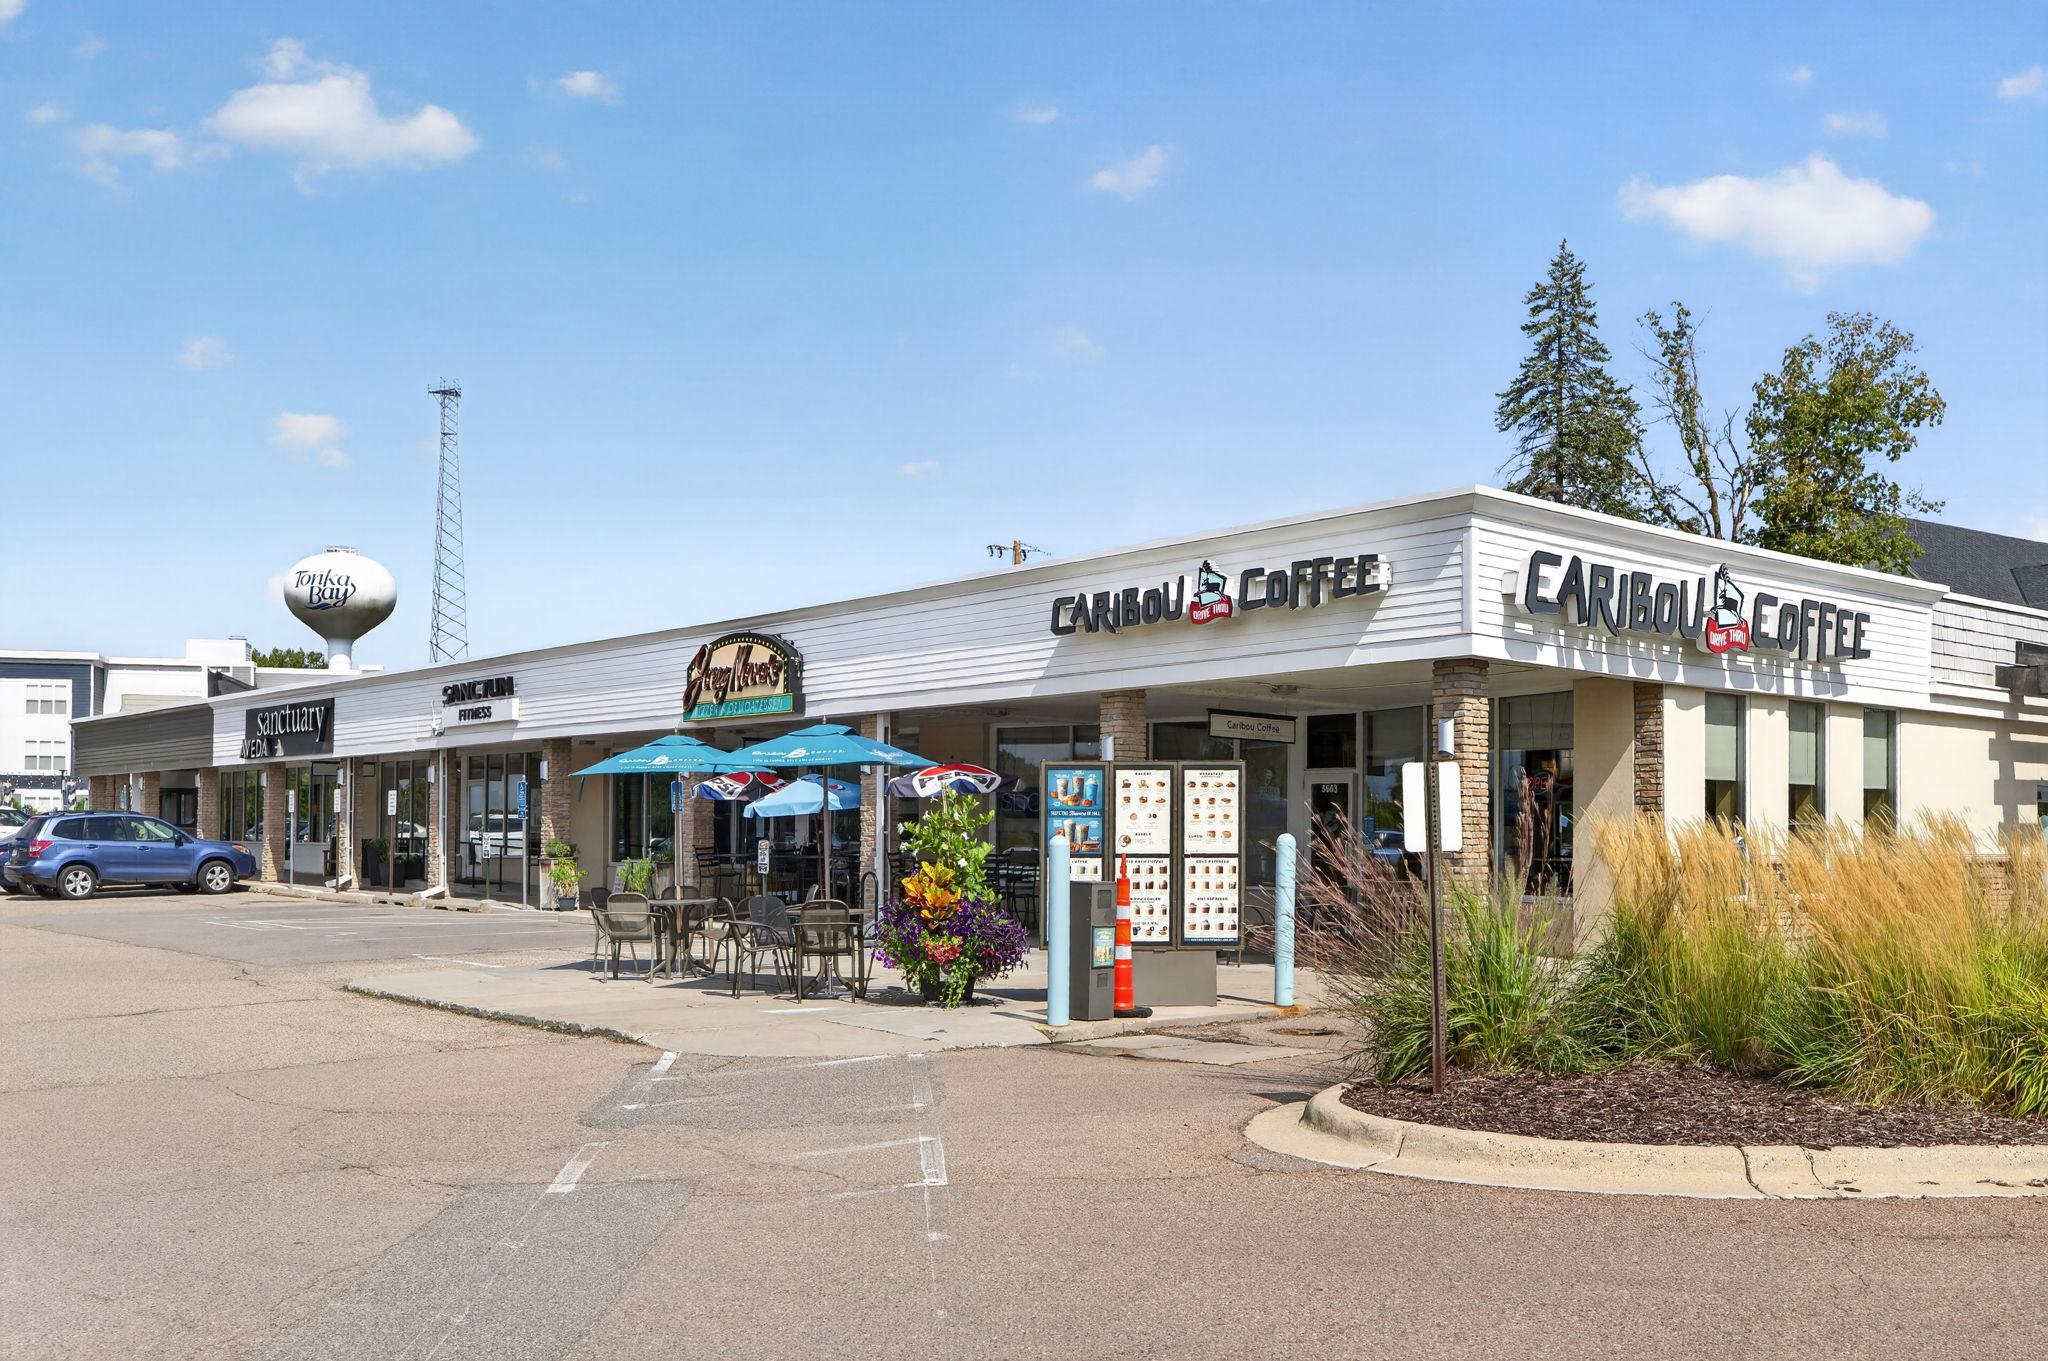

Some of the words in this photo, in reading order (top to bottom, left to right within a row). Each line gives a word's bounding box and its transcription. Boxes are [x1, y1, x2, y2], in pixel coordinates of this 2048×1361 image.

[295, 569, 350, 588] Tonka
[309, 582, 356, 607] Bay
[1050, 575, 1184, 635] CARIBOU
[1238, 554, 1380, 611] COFFEE
[1193, 608, 1210, 619] DRIVE
[1213, 603, 1228, 614] THRU
[1525, 550, 1705, 638] CARIBOU
[1752, 592, 1871, 663] COFFEE
[1710, 631, 1727, 645] DRIVE
[1729, 630, 1746, 645] THRU
[442, 676, 514, 704] SANCTUM
[257, 704, 325, 742] sanctuary
[459, 706, 492, 721] FITNESS
[1227, 720, 1254, 731] Caribou
[1256, 723, 1280, 733] Coffee
